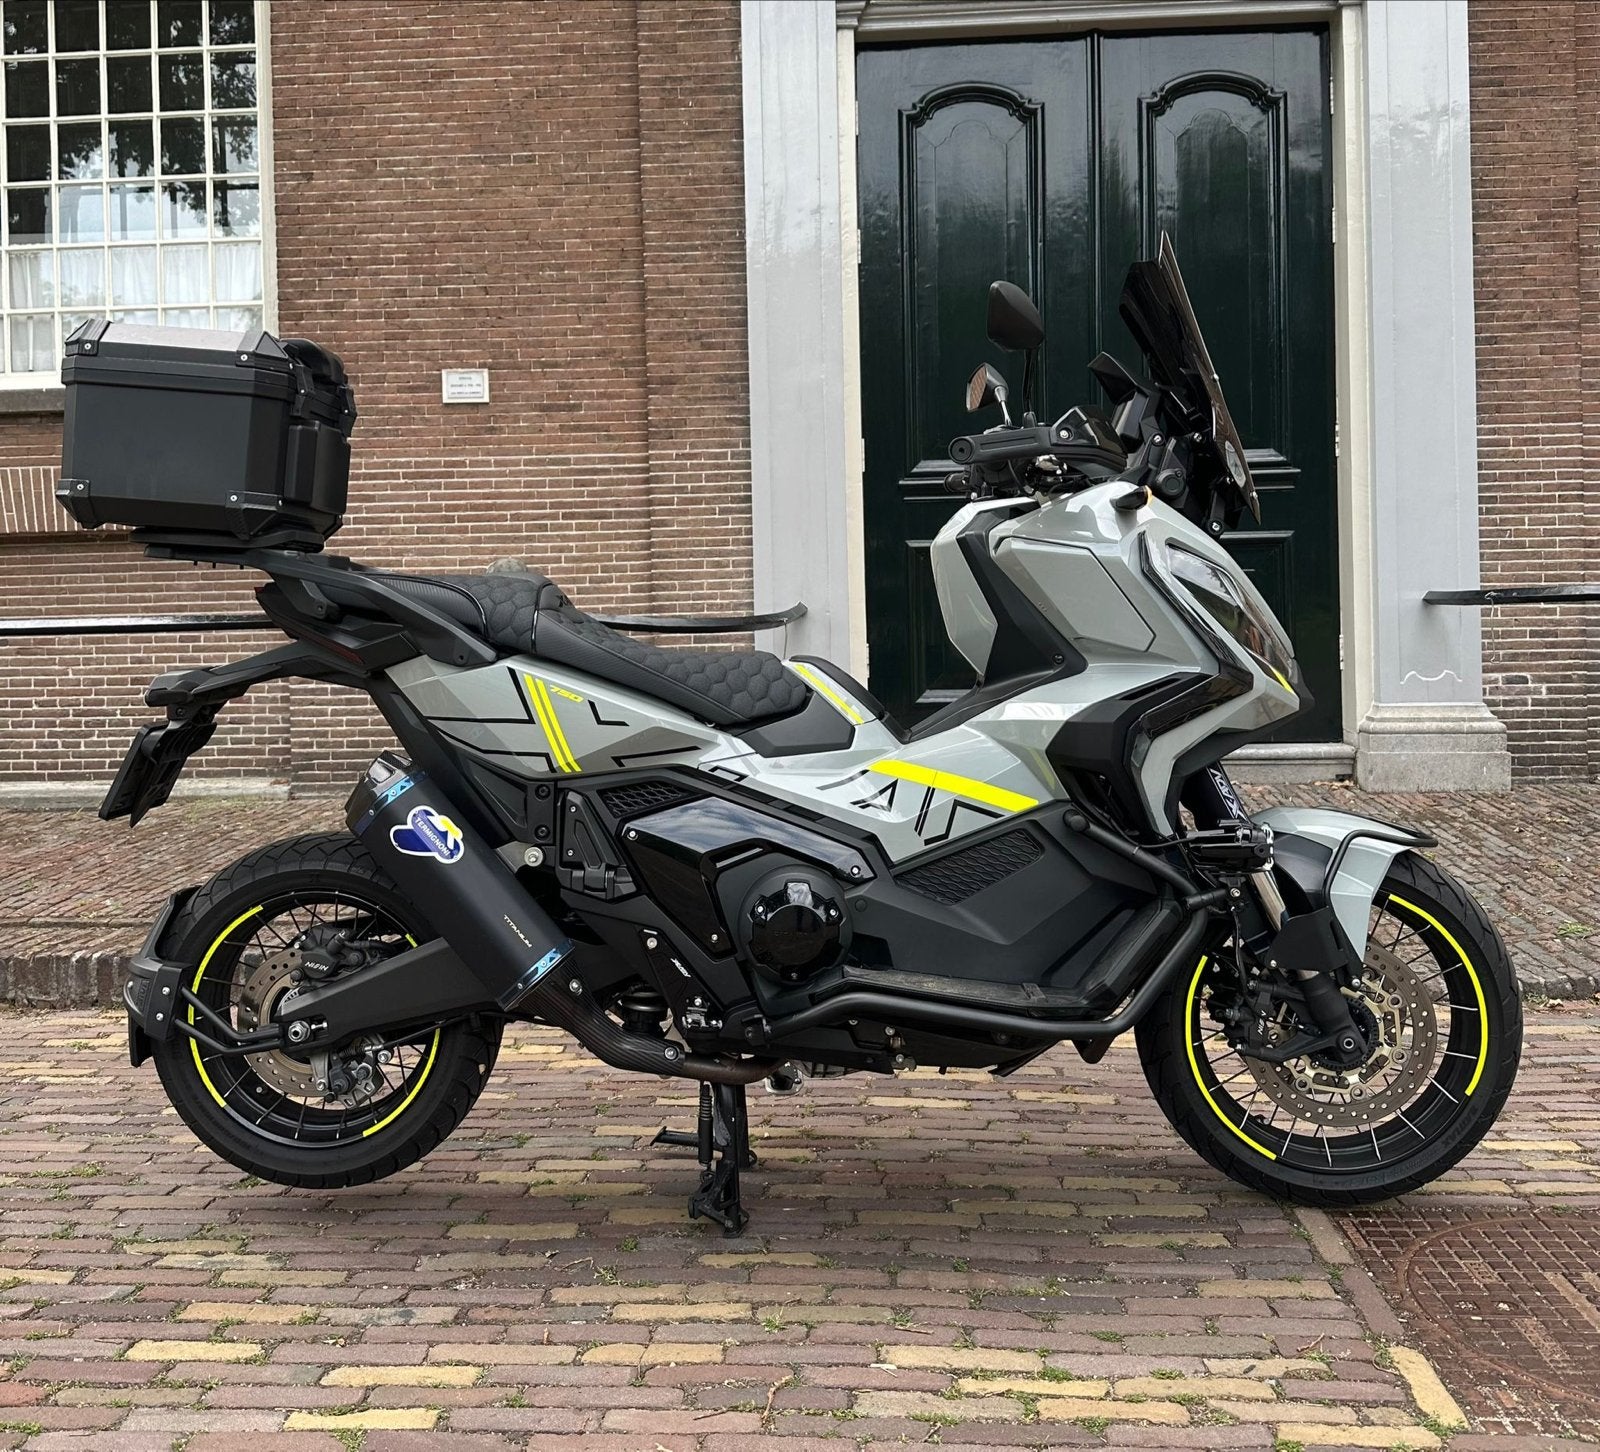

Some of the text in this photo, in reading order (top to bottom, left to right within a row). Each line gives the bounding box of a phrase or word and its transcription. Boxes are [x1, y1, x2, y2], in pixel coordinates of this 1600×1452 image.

[550, 684, 584, 703] 750
[415, 817, 451, 856] TERMIGNONI
[503, 913, 533, 948] TITANIUM
